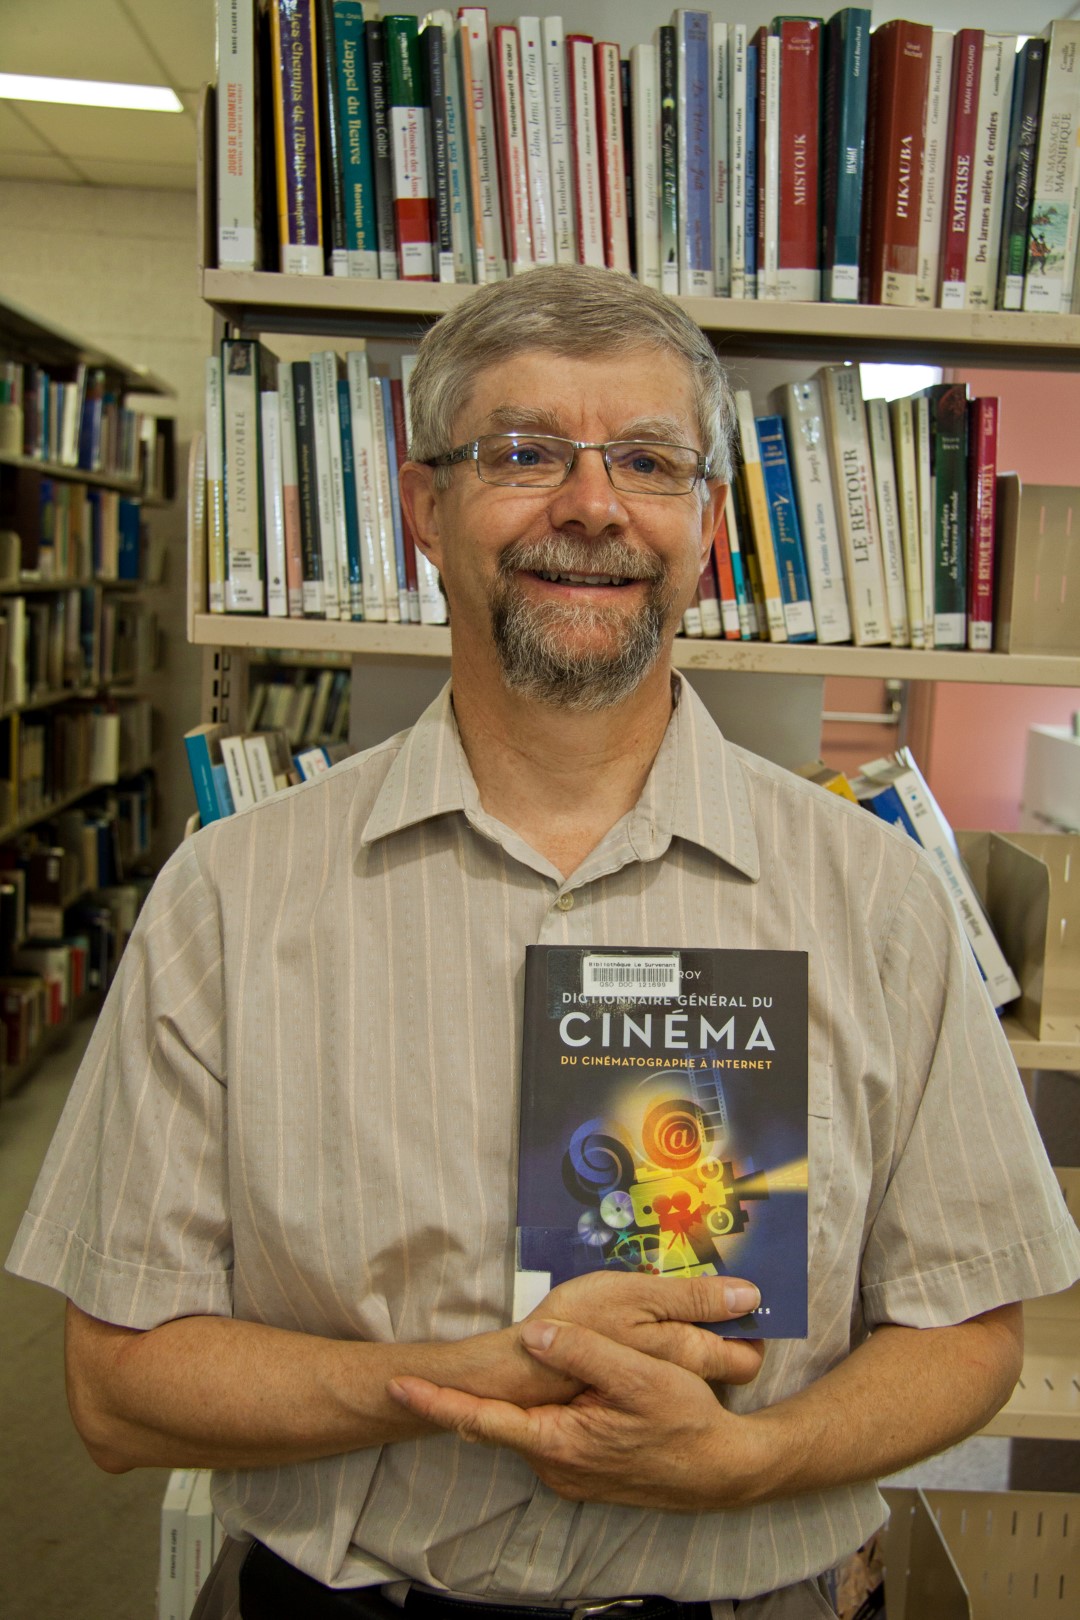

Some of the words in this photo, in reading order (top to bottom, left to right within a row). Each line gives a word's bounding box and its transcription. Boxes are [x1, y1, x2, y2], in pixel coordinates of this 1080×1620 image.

[291, 13, 303, 37] Les
[855, 26, 863, 55] Bouchard
[343, 39, 359, 92] L'appel
[505, 43, 514, 68] cœur
[853, 55, 861, 77] Gérard
[965, 44, 976, 88] BOUCHARD
[993, 41, 1003, 72] Bouchard
[1059, 44, 1070, 71] Camille
[292, 41, 304, 102] Chemins
[371, 61, 383, 83] Trois
[505, 69, 515, 81] de
[524, 53, 538, 87] Gloria
[546, 62, 562, 103] encore!
[932, 55, 943, 92] Bouchard
[373, 85, 385, 109] nuits
[527, 86, 538, 98] et
[992, 72, 1001, 97] Camille
[226, 82, 237, 133] TOURMENTE
[293, 105, 305, 124] de
[346, 95, 360, 115] du
[407, 108, 417, 119] La
[445, 95, 457, 136] fragile
[507, 82, 519, 139] Tremblement
[526, 101, 540, 126] Irma
[930, 94, 940, 125] Camille
[963, 88, 973, 115] SARAH
[375, 112, 385, 124] au
[550, 105, 568, 131] quoi
[985, 111, 999, 152] cendres
[226, 135, 237, 147] DE
[349, 120, 361, 165] fleuve
[376, 126, 389, 158] Colibri
[408, 121, 419, 157] Mémoire
[435, 118, 448, 176] L'AUDACIEUSE
[446, 141, 458, 163] fort
[528, 129, 541, 158] Edna,
[550, 134, 564, 145] Et
[1045, 113, 1061, 173] MASSACRE
[1053, 112, 1072, 194] MAGNIFIQUE
[226, 149, 238, 176] JOURS
[410, 159, 419, 172] des
[475, 125, 492, 183] Bombardier
[735, 162, 742, 171] de
[926, 138, 938, 173] soldats
[984, 153, 995, 167] de
[1017, 147, 1031, 163] de
[438, 178, 448, 189] DE
[450, 169, 461, 197] homme
[512, 145, 521, 195] Bombardier
[714, 160, 730, 204] Dérapages
[794, 133, 807, 206] MISTOUK
[896, 135, 913, 218] PIKAUBA
[411, 175, 423, 198] Âmes
[556, 159, 569, 215] Bombardier
[586, 163, 595, 214] BOMBARDIER
[924, 176, 936, 204] petits
[951, 154, 971, 233] EMPRISE
[981, 170, 994, 205] mêlées
[1014, 162, 1030, 211] L'Ombre
[1043, 176, 1054, 194] UN
[353, 183, 364, 228] Monique
[438, 191, 449, 235] NAUFRAGE
[482, 186, 494, 218] Denise
[516, 198, 524, 225] Denise
[735, 199, 742, 208] Le
[923, 205, 933, 223] Les
[559, 217, 570, 250] Denise
[588, 217, 597, 245] DENISE
[977, 207, 991, 241] larmes
[441, 237, 450, 246] LE
[974, 245, 987, 263] Des
[234, 411, 247, 513] L'INAVOUABLE
[842, 448, 867, 532] RETOUR
[948, 490, 959, 522] Monde
[884, 514, 894, 527] DU
[939, 503, 951, 549] Templiers
[852, 536, 870, 564] LE
[949, 523, 959, 565] Nouveau
[939, 551, 950, 567] Les
[948, 565, 959, 580] du
[977, 543, 992, 581] RETOUR
[890, 570, 899, 581] LA
[977, 585, 990, 597] LE
[588, 961, 632, 970] Bibliothèque
[678, 970, 702, 980] ROY
[562, 992, 672, 1006] DICTIONNAIRE
[677, 992, 747, 1008] GÉNÉRAL
[752, 997, 773, 1008] DU
[559, 1009, 776, 1051] CINÉMA
[561, 1055, 578, 1065] DU
[582, 1055, 696, 1068] CINÉMATOGRAPHE
[700, 1056, 708, 1068] À
[712, 1059, 773, 1070] INTERNET
